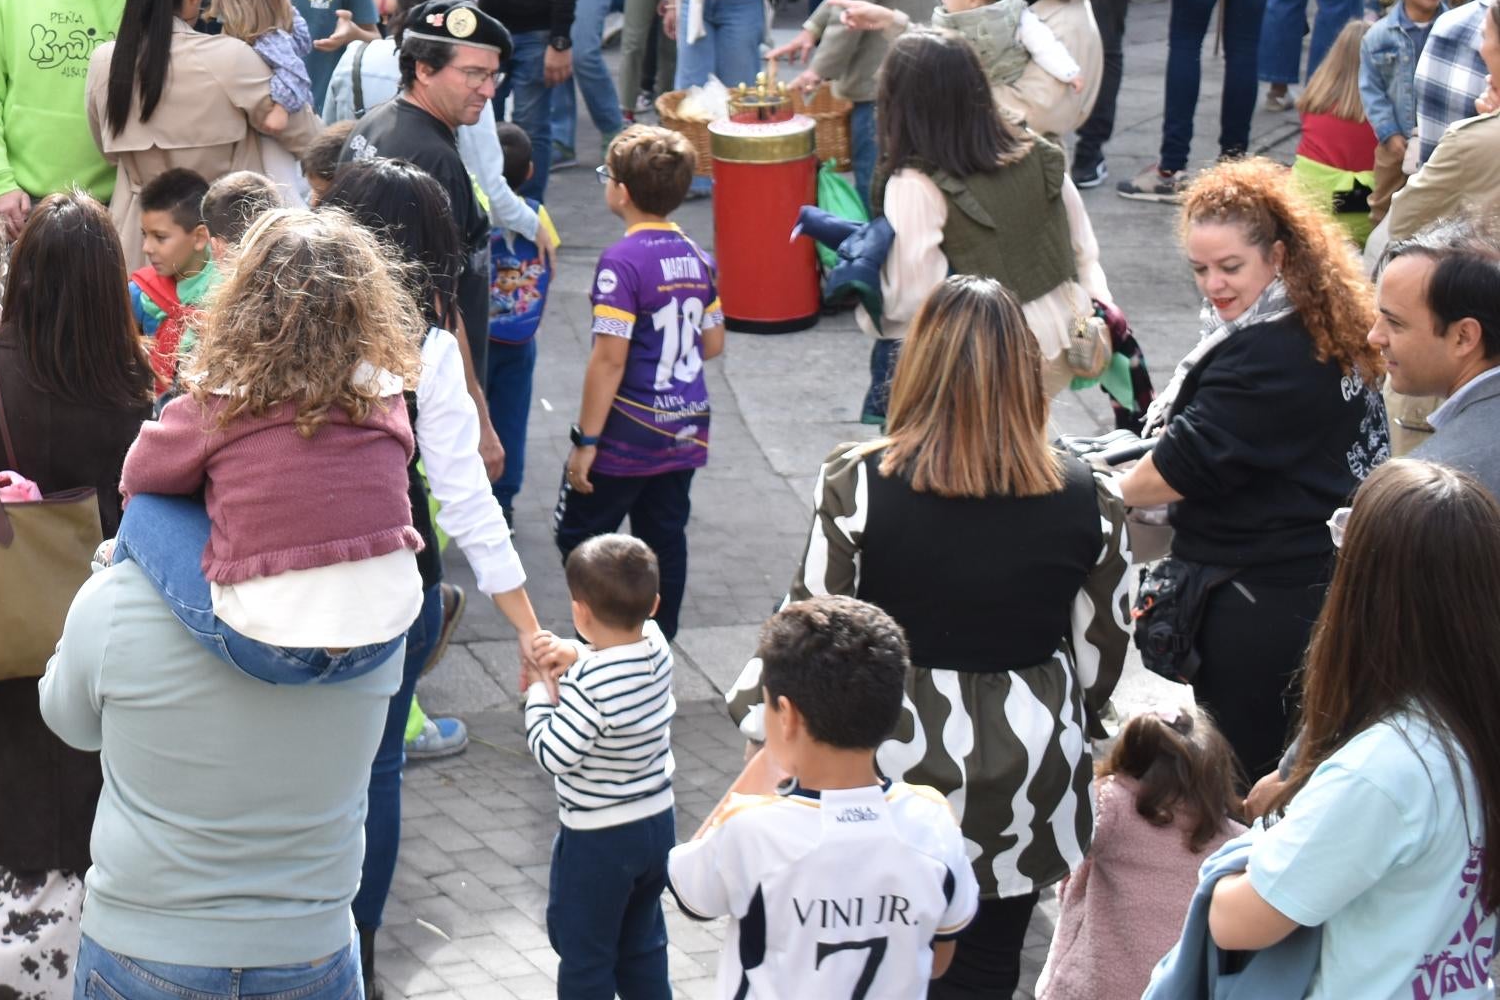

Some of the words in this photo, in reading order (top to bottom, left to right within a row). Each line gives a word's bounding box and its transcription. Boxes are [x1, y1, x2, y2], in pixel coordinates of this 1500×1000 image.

[792, 897, 864, 929] VINI
[873, 894, 920, 927] JR.
[814, 936, 889, 1000] 7
